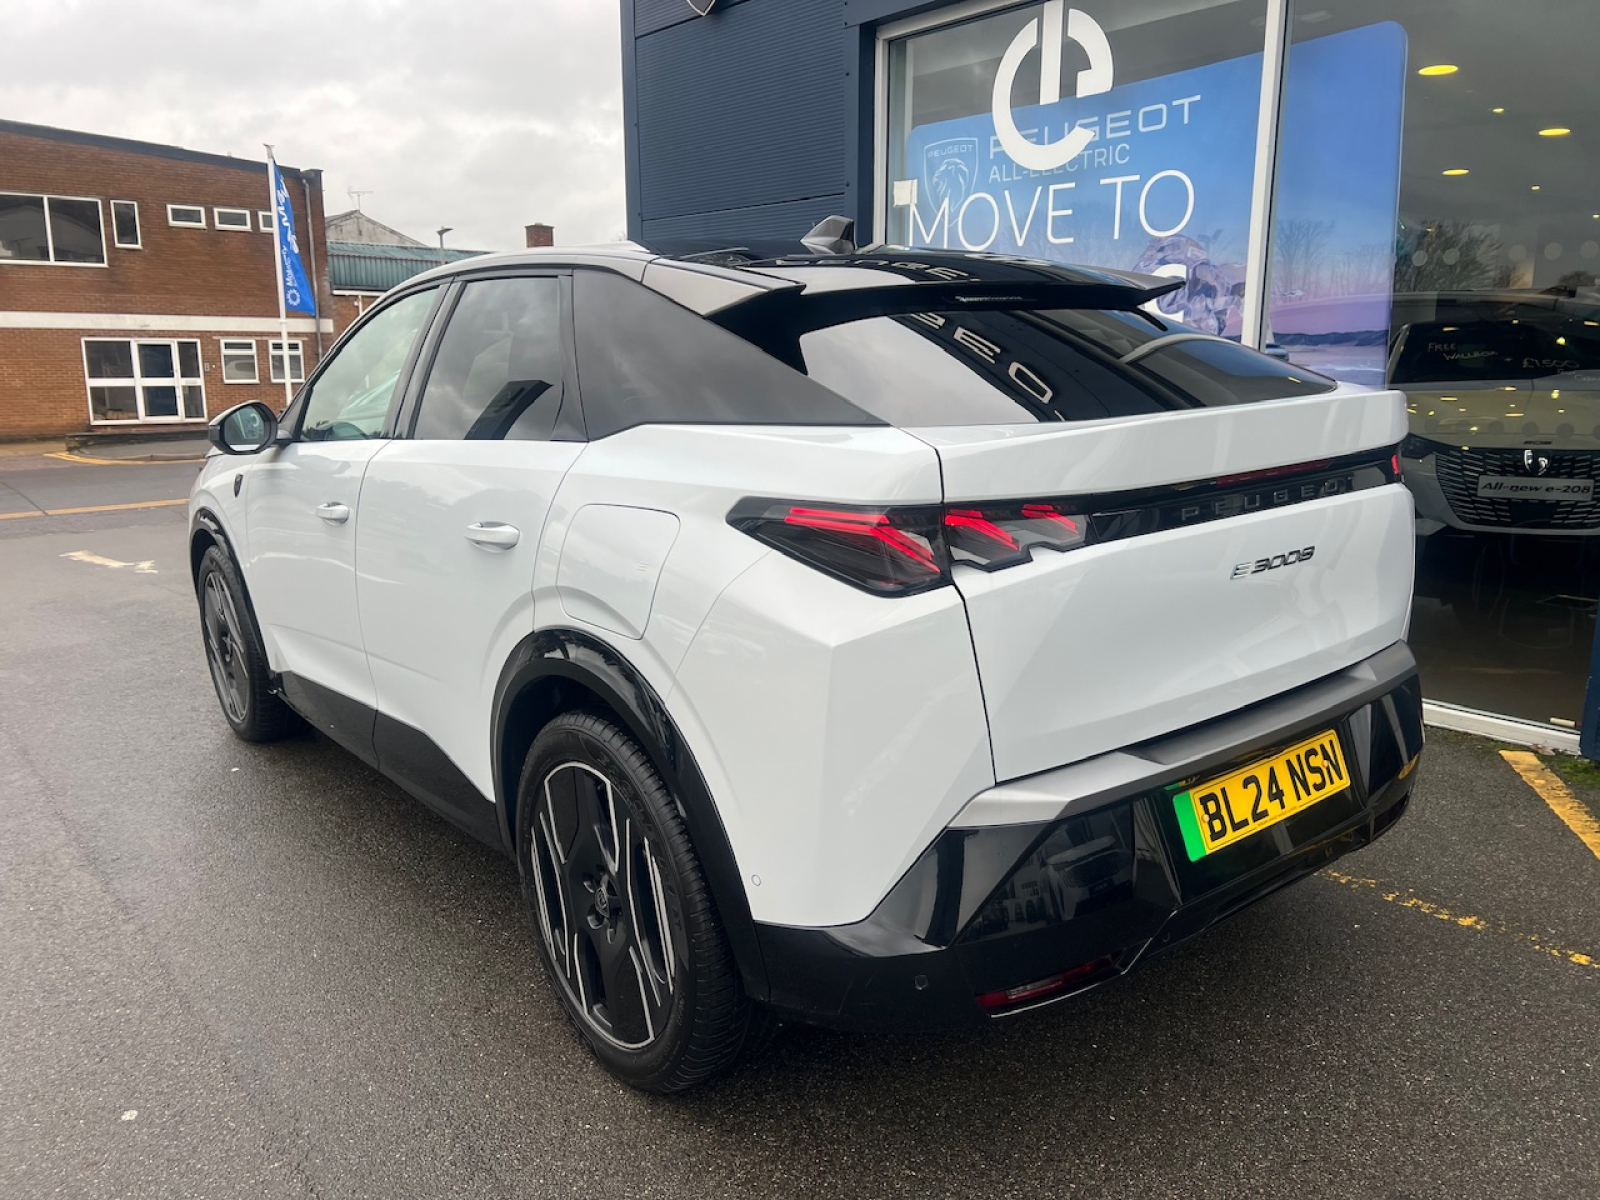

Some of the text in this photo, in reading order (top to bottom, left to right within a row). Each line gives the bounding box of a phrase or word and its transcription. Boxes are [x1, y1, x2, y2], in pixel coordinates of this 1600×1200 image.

[927, 144, 974, 159] PEUGEOT
[989, 143, 1131, 184] ALL-CTRIC
[909, 169, 1195, 252] MOVE TO
[1428, 342, 1457, 353] FREE
[1481, 481, 1591, 494] All-new e-208
[1198, 739, 1344, 843] BL24 NSN
